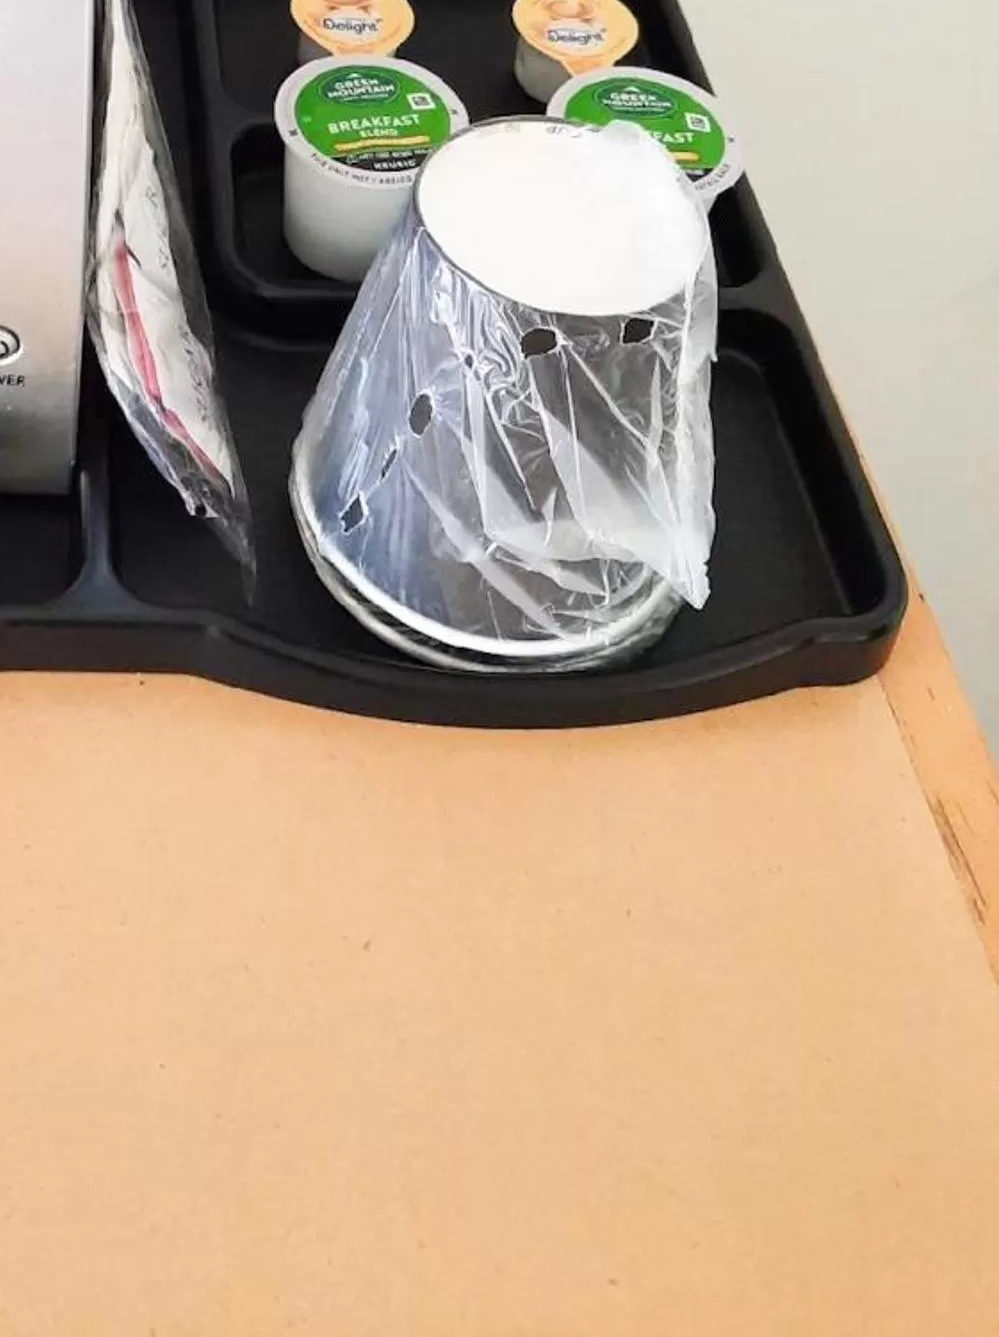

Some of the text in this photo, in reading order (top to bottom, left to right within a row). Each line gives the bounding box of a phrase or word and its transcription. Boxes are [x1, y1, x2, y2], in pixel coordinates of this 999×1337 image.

[322, 17, 379, 35] Delight
[327, 84, 395, 99] MOUNTAIN
[334, 78, 380, 91] GREEN
[609, 91, 657, 102] GREEN
[327, 114, 421, 135] BREAKFAST
[358, 127, 399, 138] BLEND
